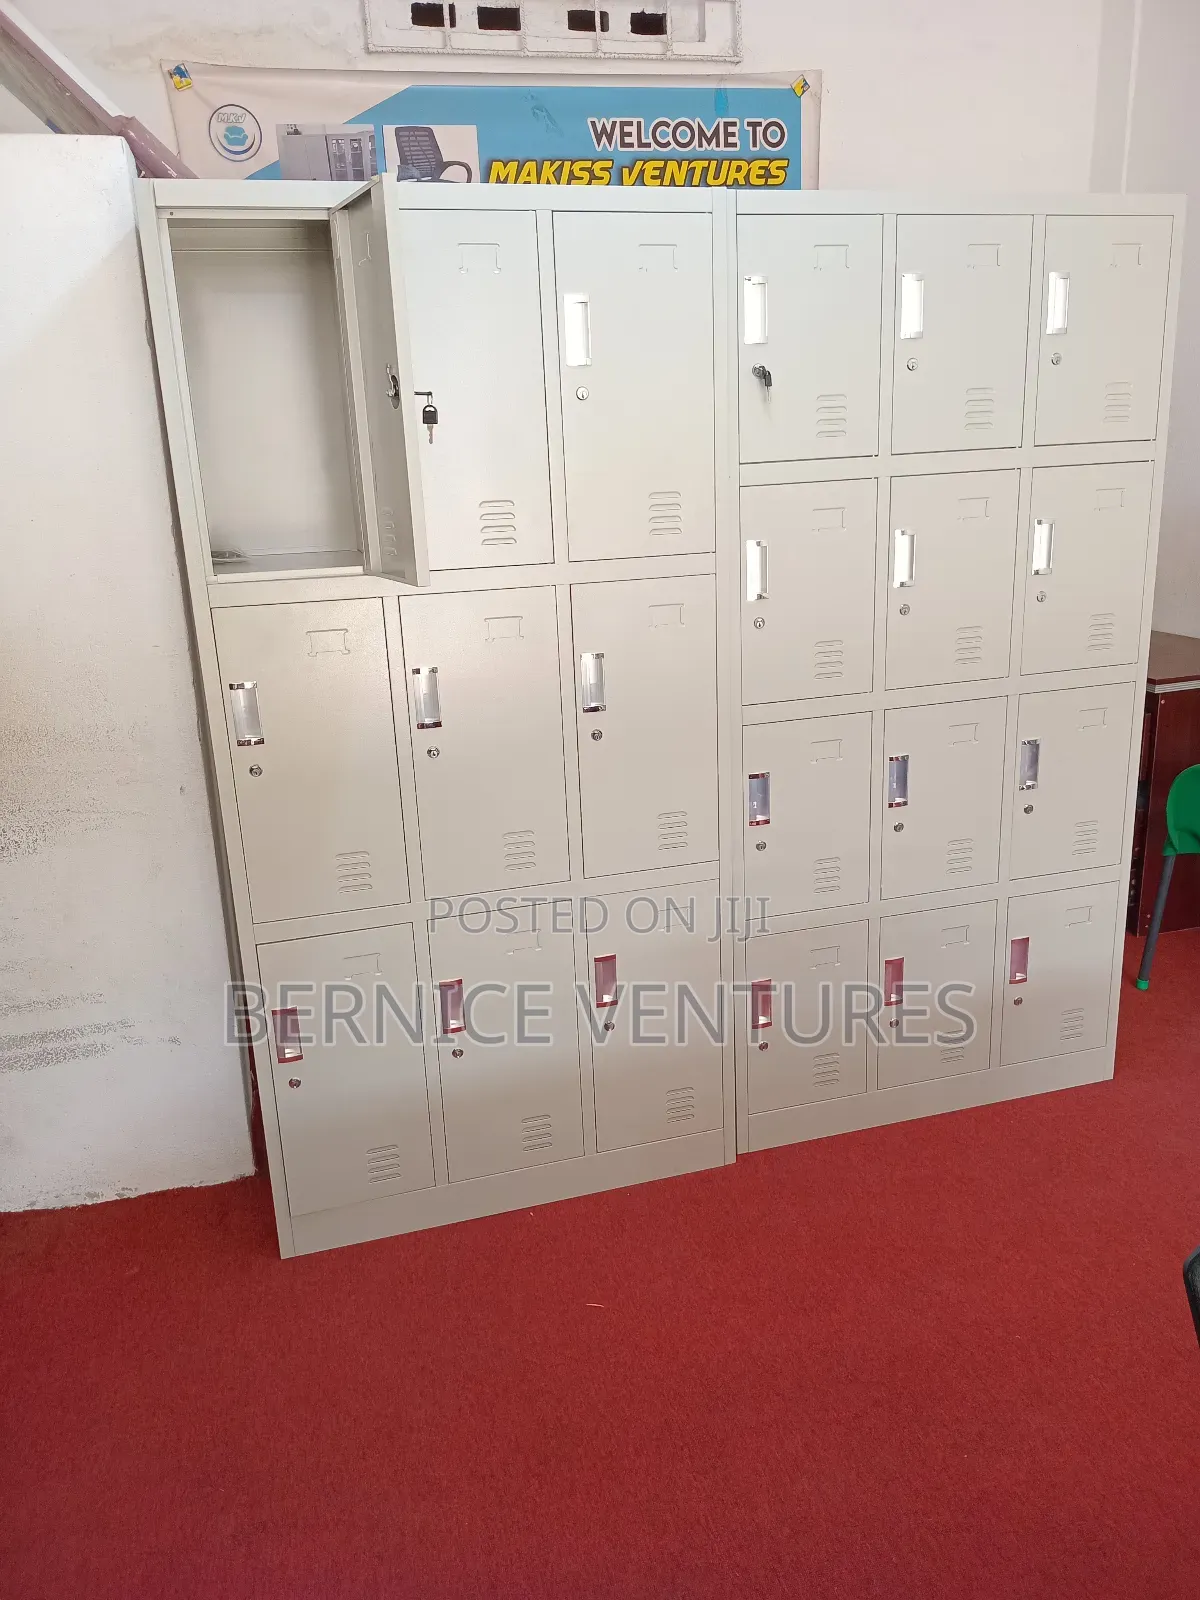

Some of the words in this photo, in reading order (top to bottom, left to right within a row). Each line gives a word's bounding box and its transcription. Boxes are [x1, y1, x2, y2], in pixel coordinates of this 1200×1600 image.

[588, 118, 740, 151] WELCOME
[746, 118, 788, 151] TO
[489, 159, 614, 186] MAKISS
[621, 158, 789, 187] VENTURES
